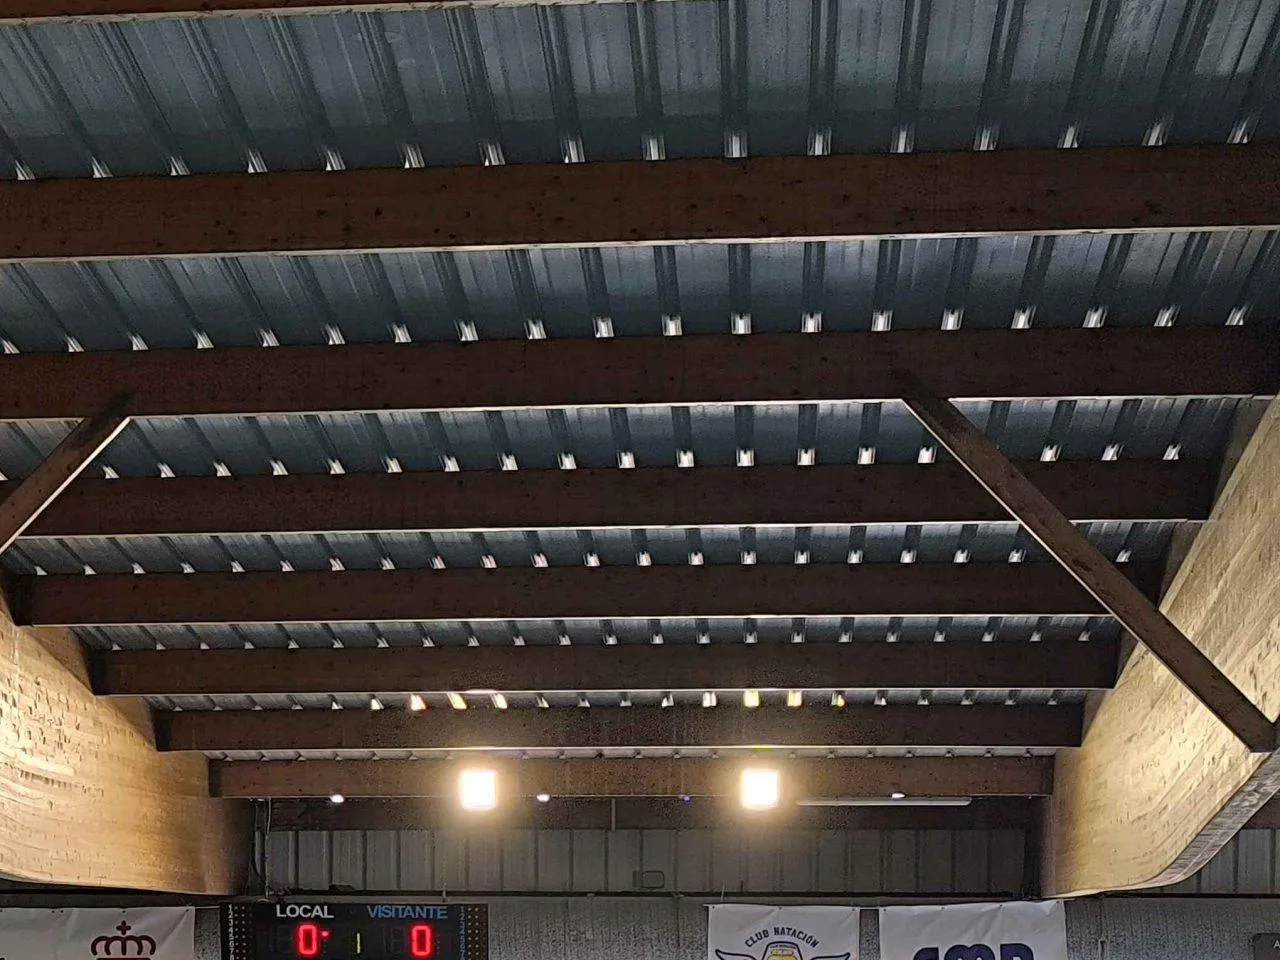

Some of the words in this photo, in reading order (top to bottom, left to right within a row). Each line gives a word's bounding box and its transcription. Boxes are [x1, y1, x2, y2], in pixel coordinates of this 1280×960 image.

[275, 904, 335, 919] LOCAL
[367, 905, 448, 920] VISITANTE
[298, 923, 319, 956] 0
[411, 924, 432, 957] 0
[745, 929, 770, 948] CLUB
[773, 927, 820, 948] NATACIÓN
